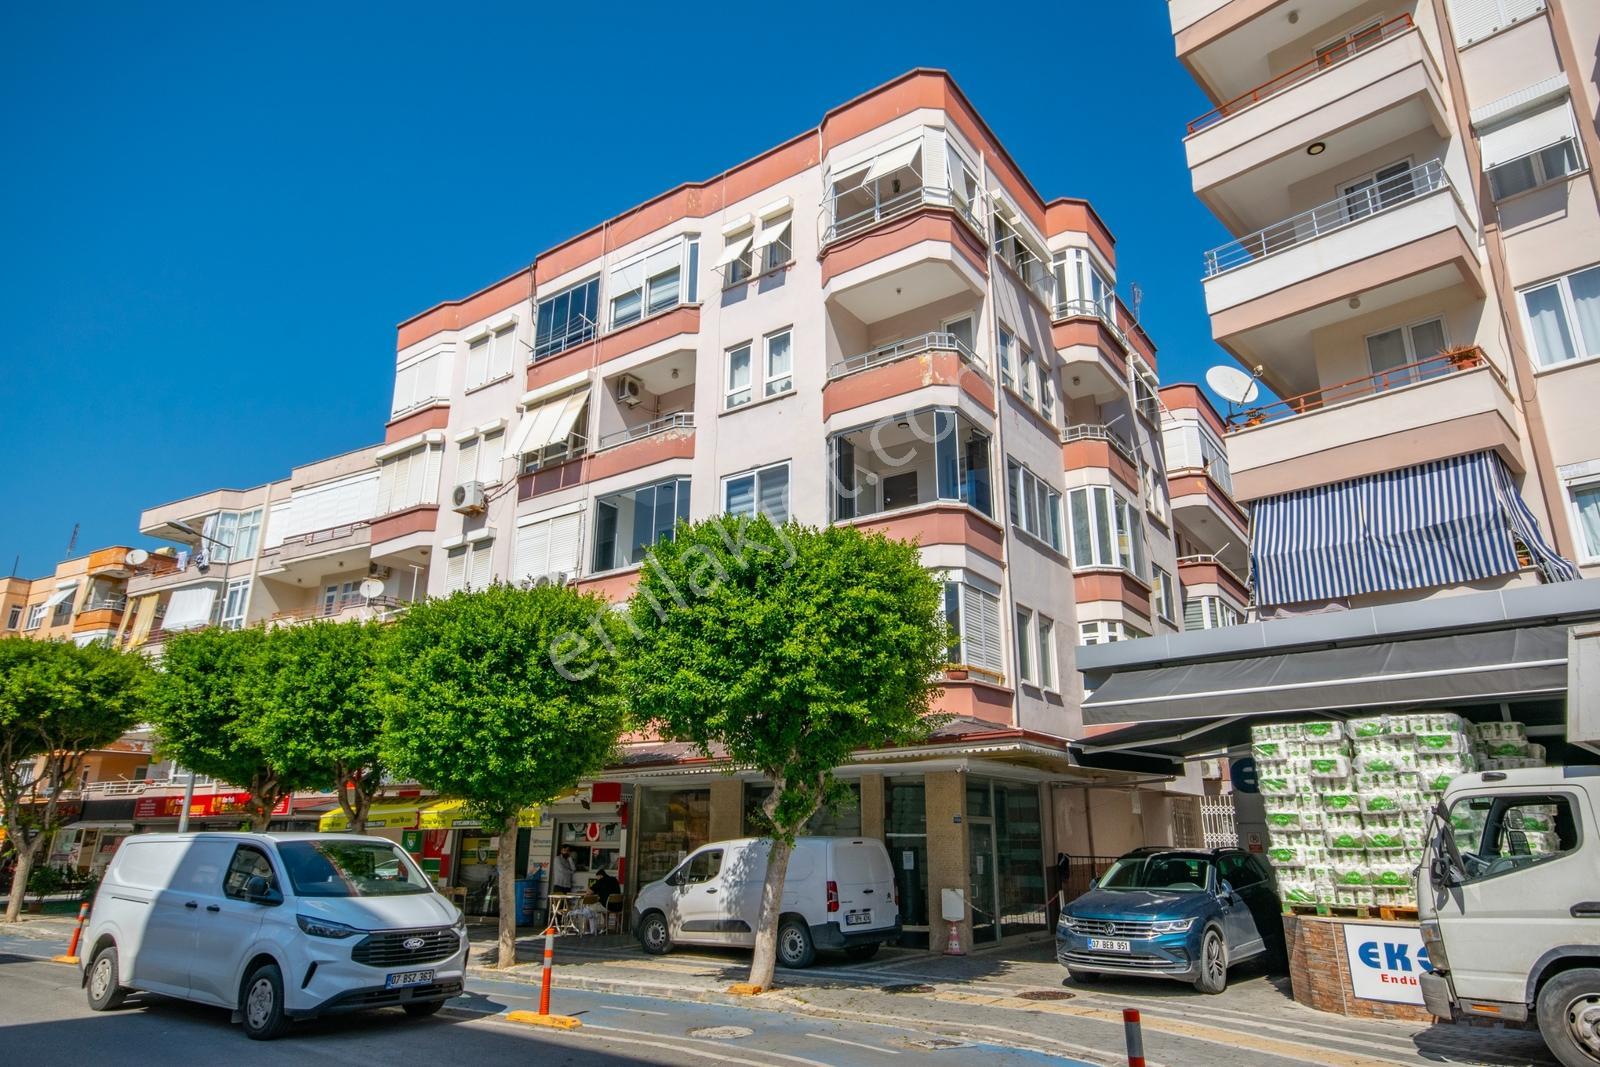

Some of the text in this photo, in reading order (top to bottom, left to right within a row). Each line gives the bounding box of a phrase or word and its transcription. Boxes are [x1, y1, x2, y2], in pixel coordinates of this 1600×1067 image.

[1092, 940, 1099, 949] 07
[1117, 942, 1128, 950] 951
[391, 971, 432, 984] 07 BSZ 363
[1381, 974, 1417, 985] Endü
